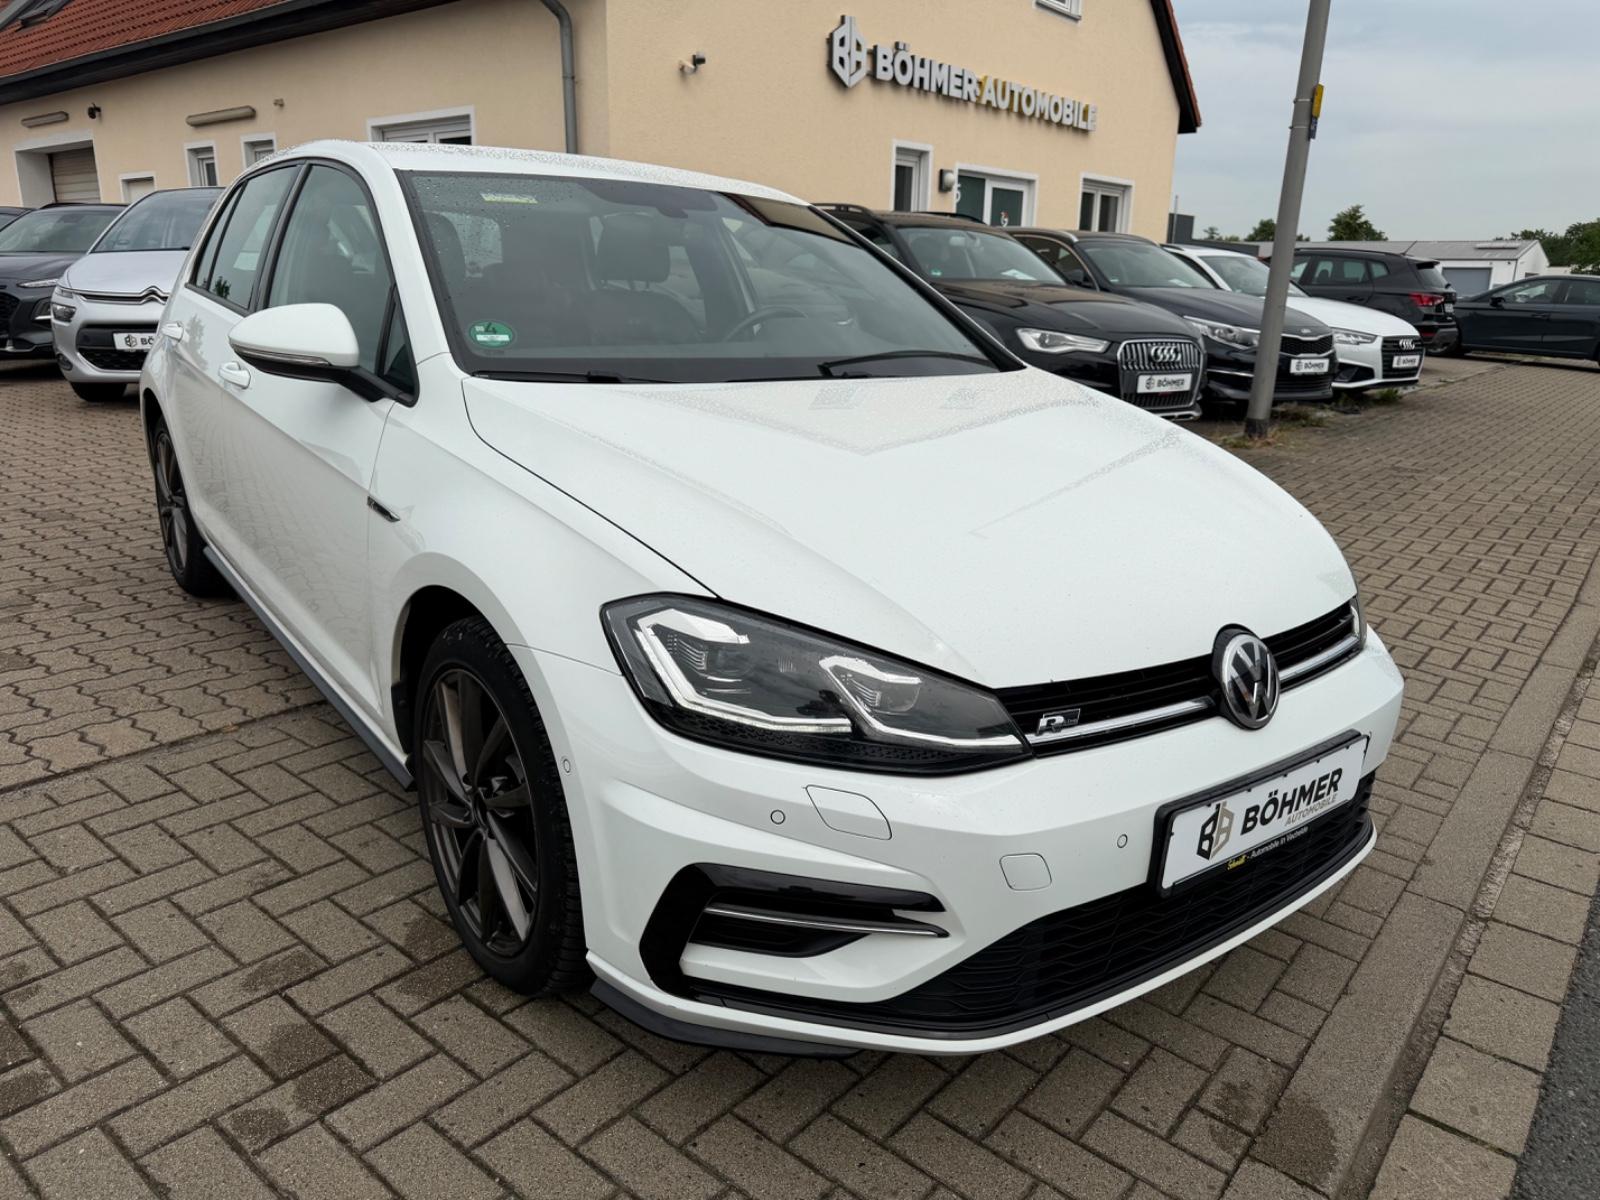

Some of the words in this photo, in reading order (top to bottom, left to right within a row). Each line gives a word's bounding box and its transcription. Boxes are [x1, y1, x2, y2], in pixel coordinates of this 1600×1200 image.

[873, 41, 980, 103] BÖHMER
[979, 75, 1098, 132] AUTOMOBILE
[1156, 377, 1185, 388] BÖHMER
[1240, 767, 1343, 836] BÖHMER
[1284, 793, 1338, 827] AUTOMOBILE
